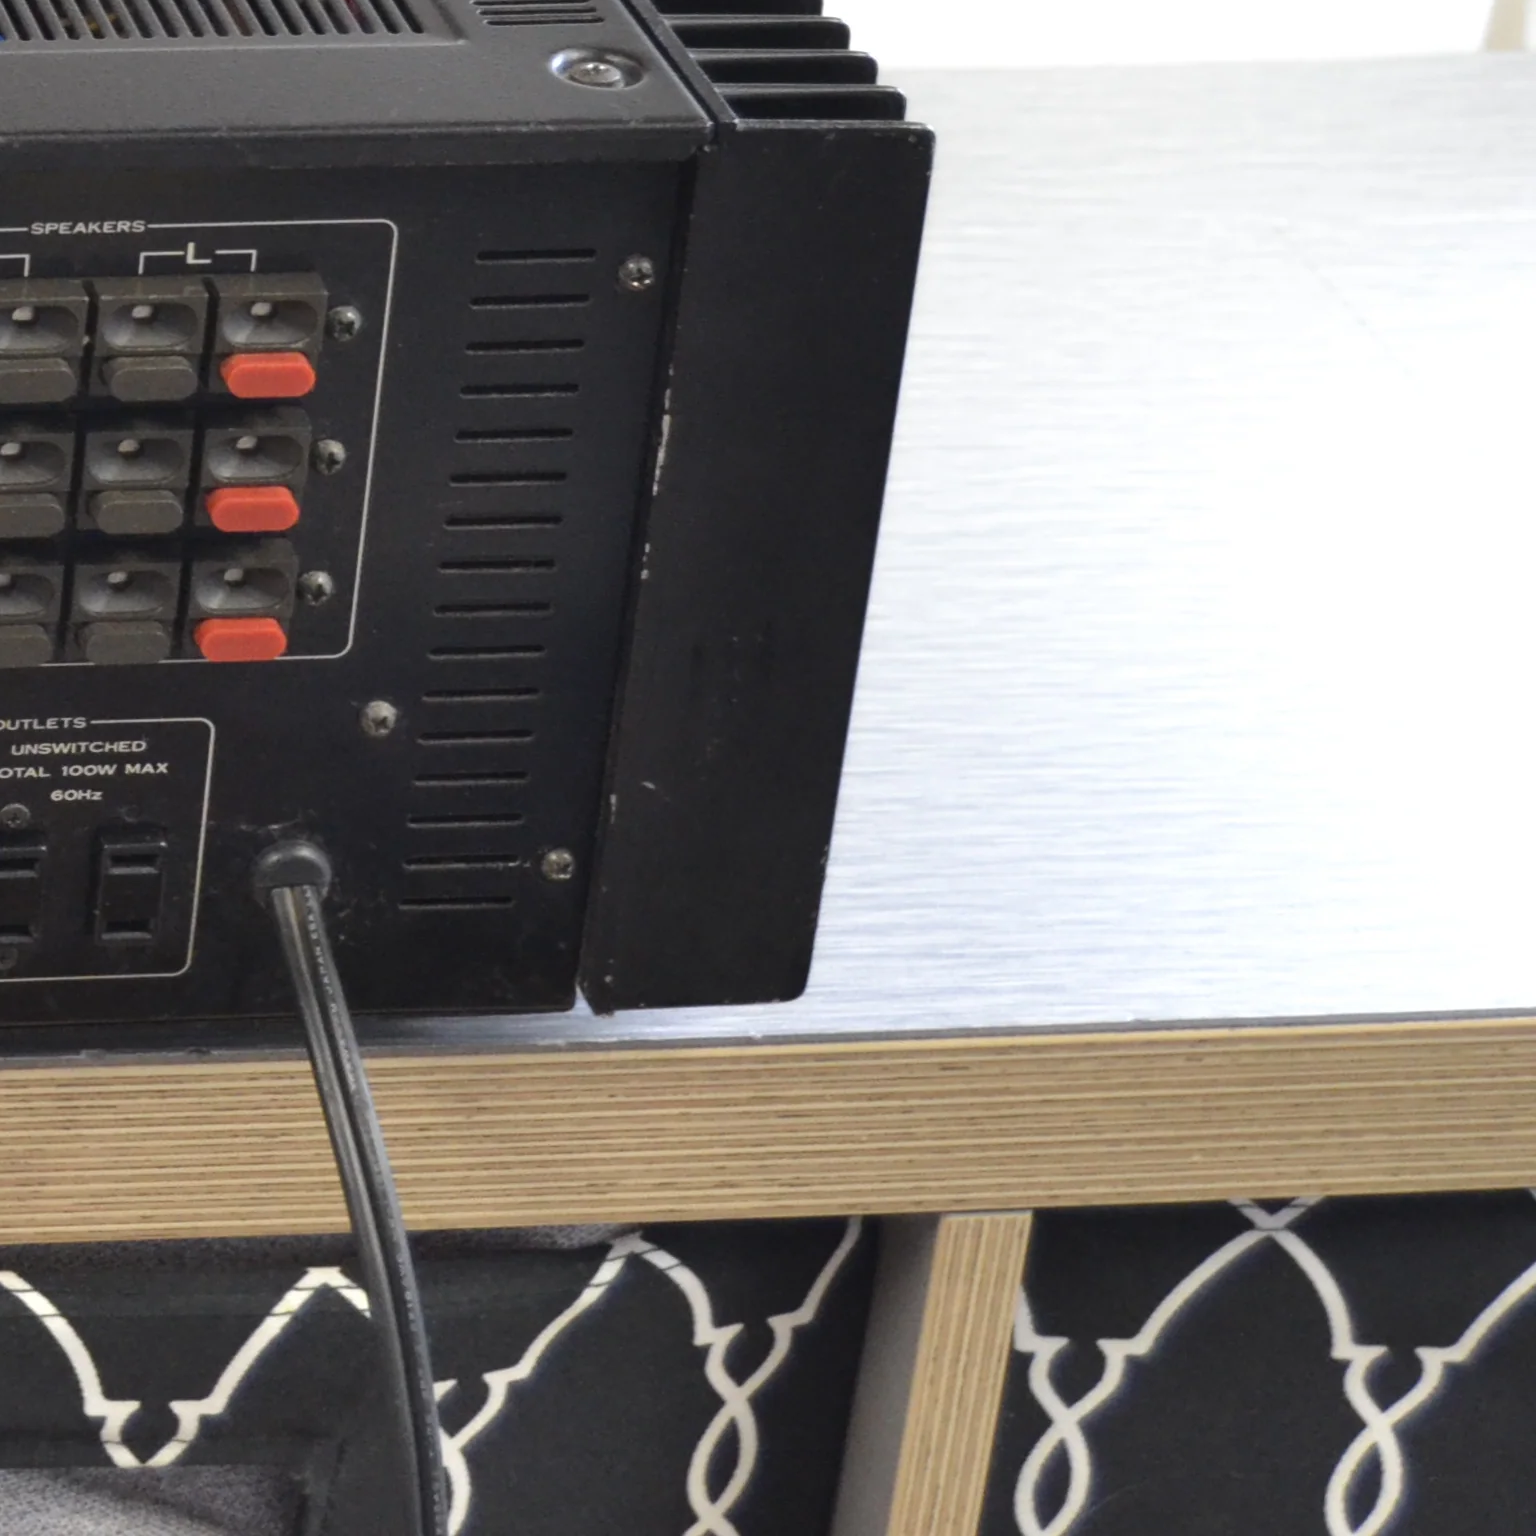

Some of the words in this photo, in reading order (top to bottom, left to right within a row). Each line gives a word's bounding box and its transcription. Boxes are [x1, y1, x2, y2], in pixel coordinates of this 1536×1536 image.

[30, 220, 146, 235] SPEAKERS
[185, 242, 212, 264] L
[11, 741, 147, 756] UNSWITCHED
[61, 764, 118, 777] 100W
[124, 762, 169, 775] MAX
[50, 788, 103, 802] 60Hz
